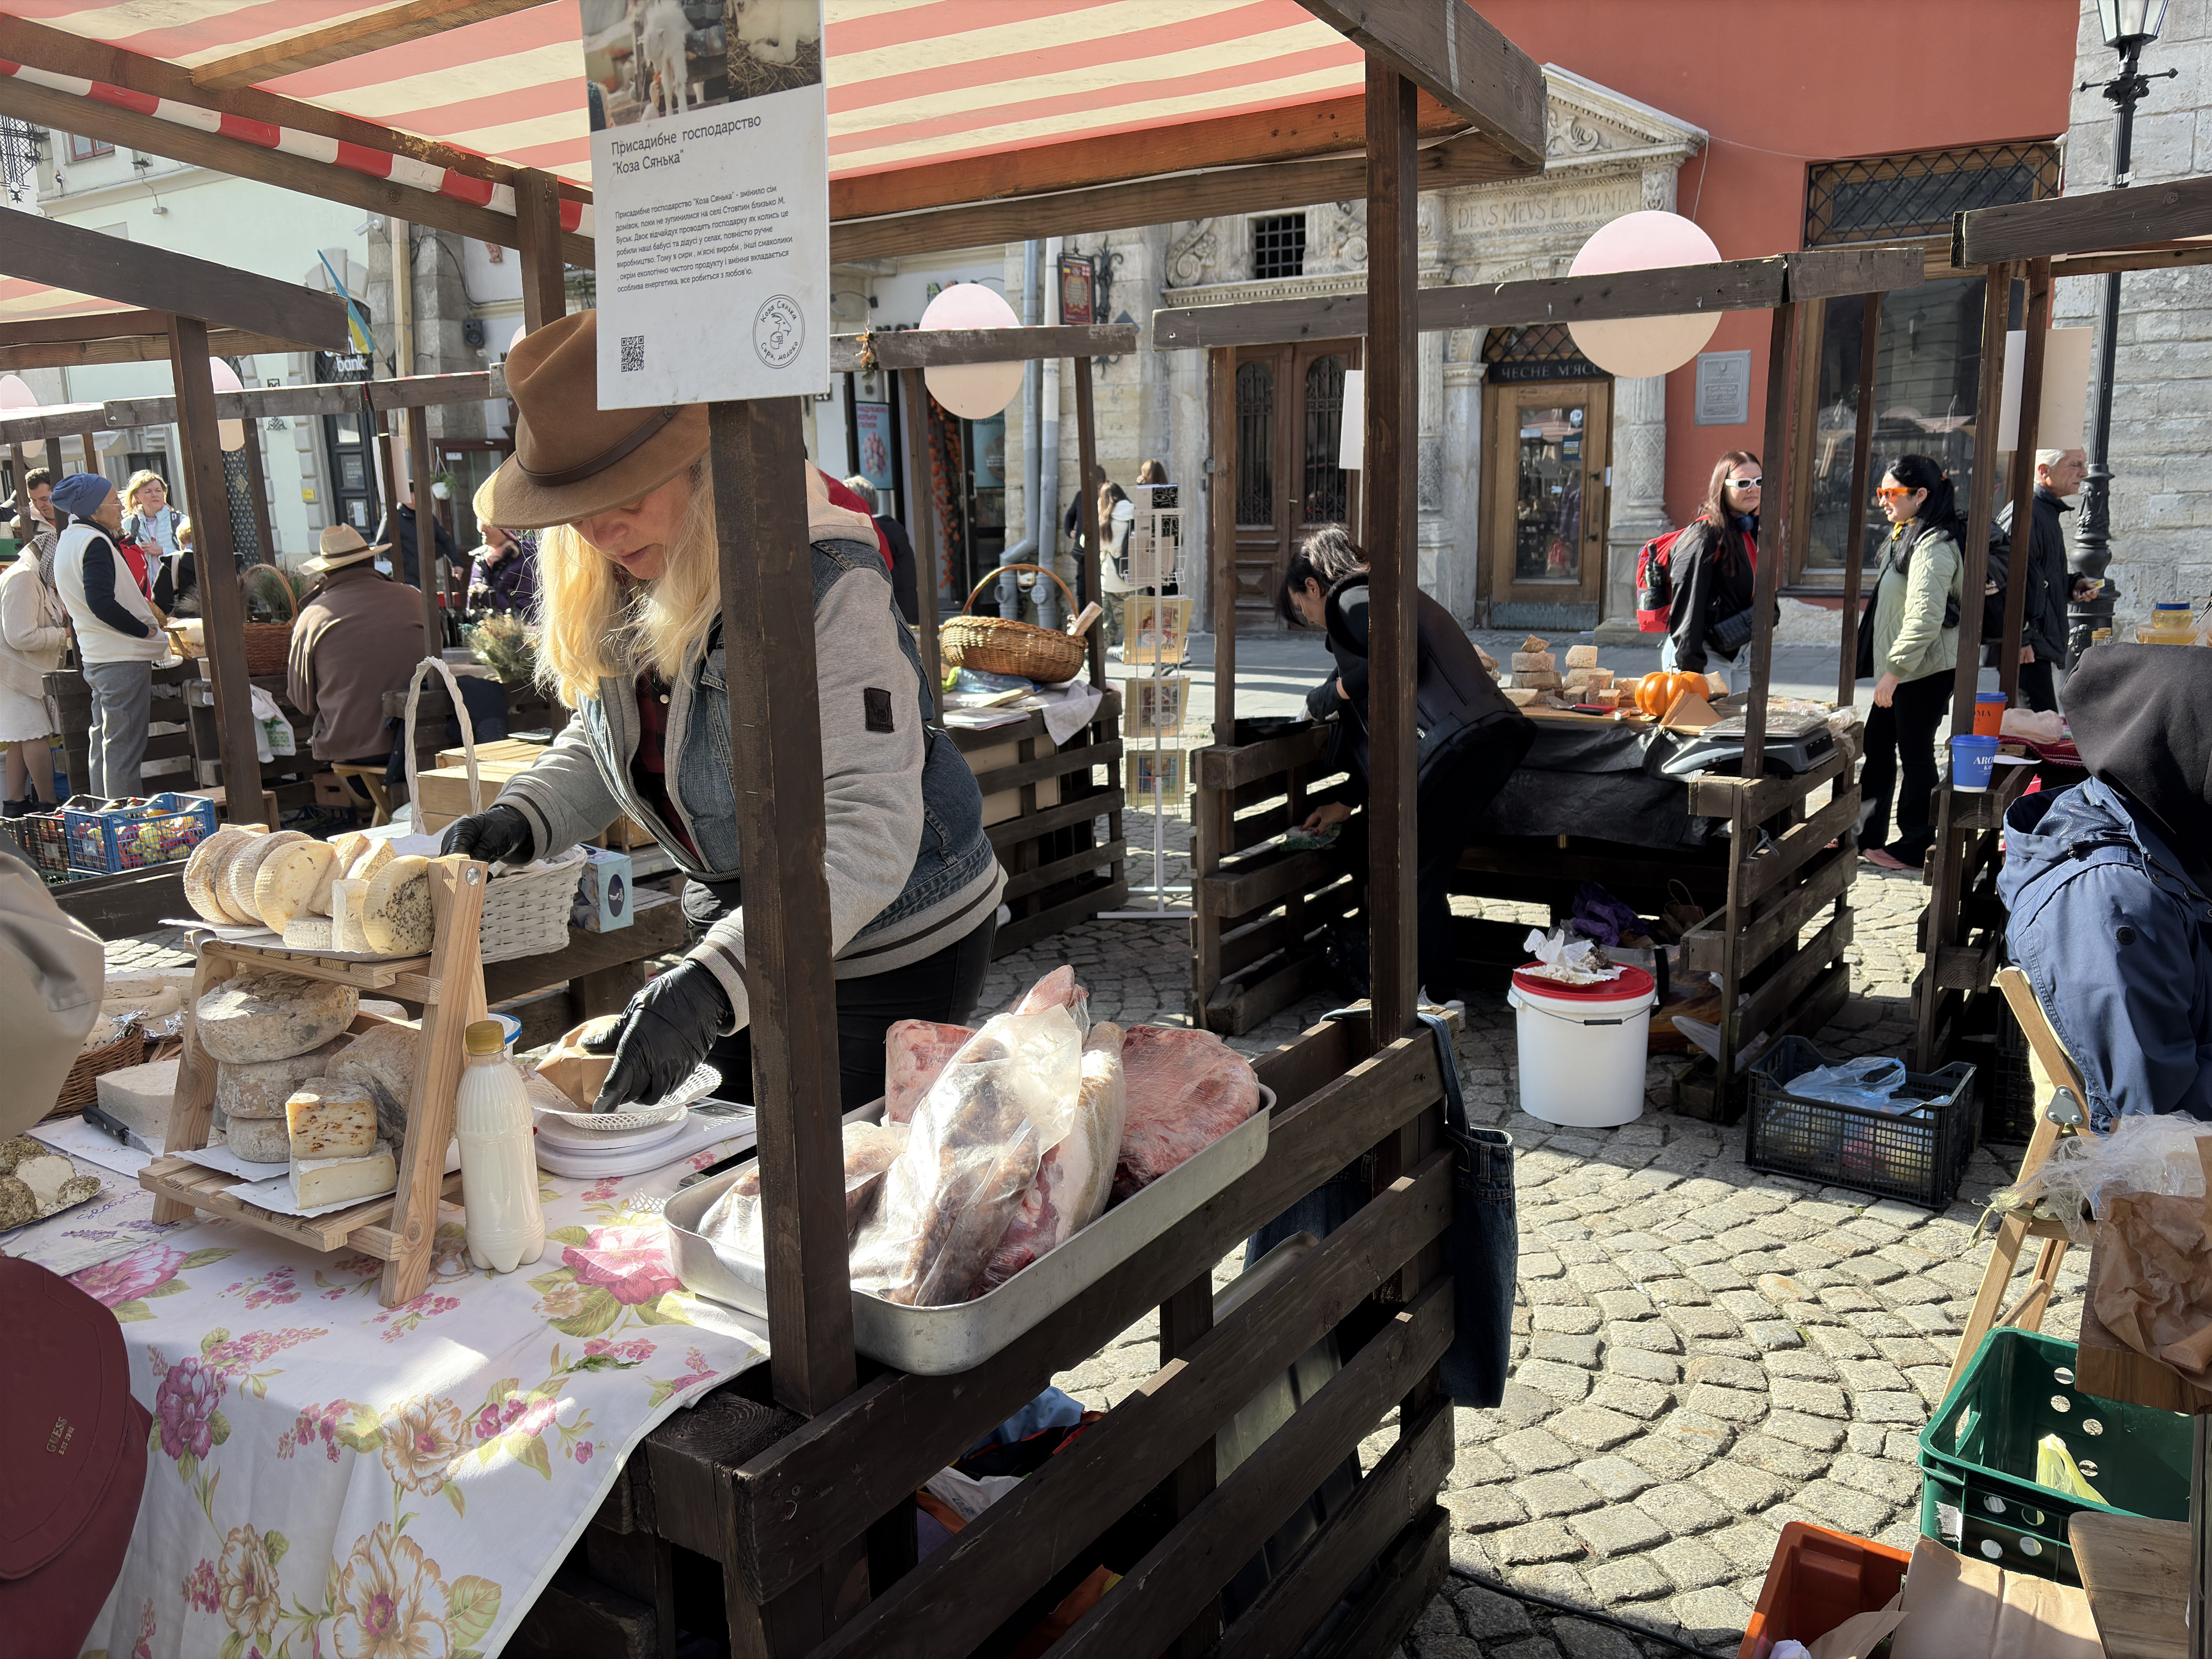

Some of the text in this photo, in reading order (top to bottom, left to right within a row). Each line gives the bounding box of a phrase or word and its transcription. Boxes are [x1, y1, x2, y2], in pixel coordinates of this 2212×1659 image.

[612, 116, 761, 157] Присадибне господарство
[612, 149, 684, 175] "Коза Сянька"
[615, 207, 650, 220] Присадибне
[651, 200, 692, 213] господарство
[693, 197, 709, 206] "Коза
[711, 191, 734, 202] Сянька"
[740, 187, 765, 198] змінило
[766, 185, 777, 193] сім
[615, 223, 639, 232] домівок,
[641, 220, 655, 228] поки
[665, 212, 700, 224] зупинилися
[709, 206, 722, 216] селі
[723, 204, 750, 214] Стовпин
[752, 199, 776, 209] близько
[1551, 195, 1570, 220] ET
[1576, 189, 1634, 216] OMNIA
[616, 236, 633, 245] Буськ.
[634, 233, 649, 242] Двоє
[650, 229, 678, 238] відчайдух
[679, 223, 711, 235] проводять
[758, 212, 779, 221] колись
[617, 247, 637, 258] робили
[638, 244, 652, 253] наші
[653, 240, 671, 251] бабусі
[680, 236, 698, 247] дідусі
[704, 234, 722, 242] селах,
[723, 229, 753, 239] повністю
[754, 226, 773, 236] ручне
[617, 258, 655, 269] виробництво.
[656, 254, 672, 262] Тому
[678, 251, 692, 260] сири
[697, 246, 715, 256] м'ясні
[716, 243, 739, 253] вироби
[744, 241, 757, 249] інші
[758, 236, 793, 247] смаколики
[620, 272, 636, 280] окрім
[637, 268, 669, 277] екологічно
[670, 264, 693, 273] чистого
[695, 259, 723, 271] продукту
[728, 255, 749, 264] вміння
[750, 250, 789, 261] вкладається
[617, 283, 644, 293] особлива
[645, 279, 679, 289] енергетика,
[691, 273, 719, 284] робиться
[725, 268, 753, 278] любов'ю.
[760, 300, 797, 322] Коза Сянька
[336, 354, 367, 372] bank
[761, 341, 798, 361] Сири, молоко
[1501, 364, 1549, 379] ЧЕСНЕ
[46, 1416, 67, 1452] GUESS
